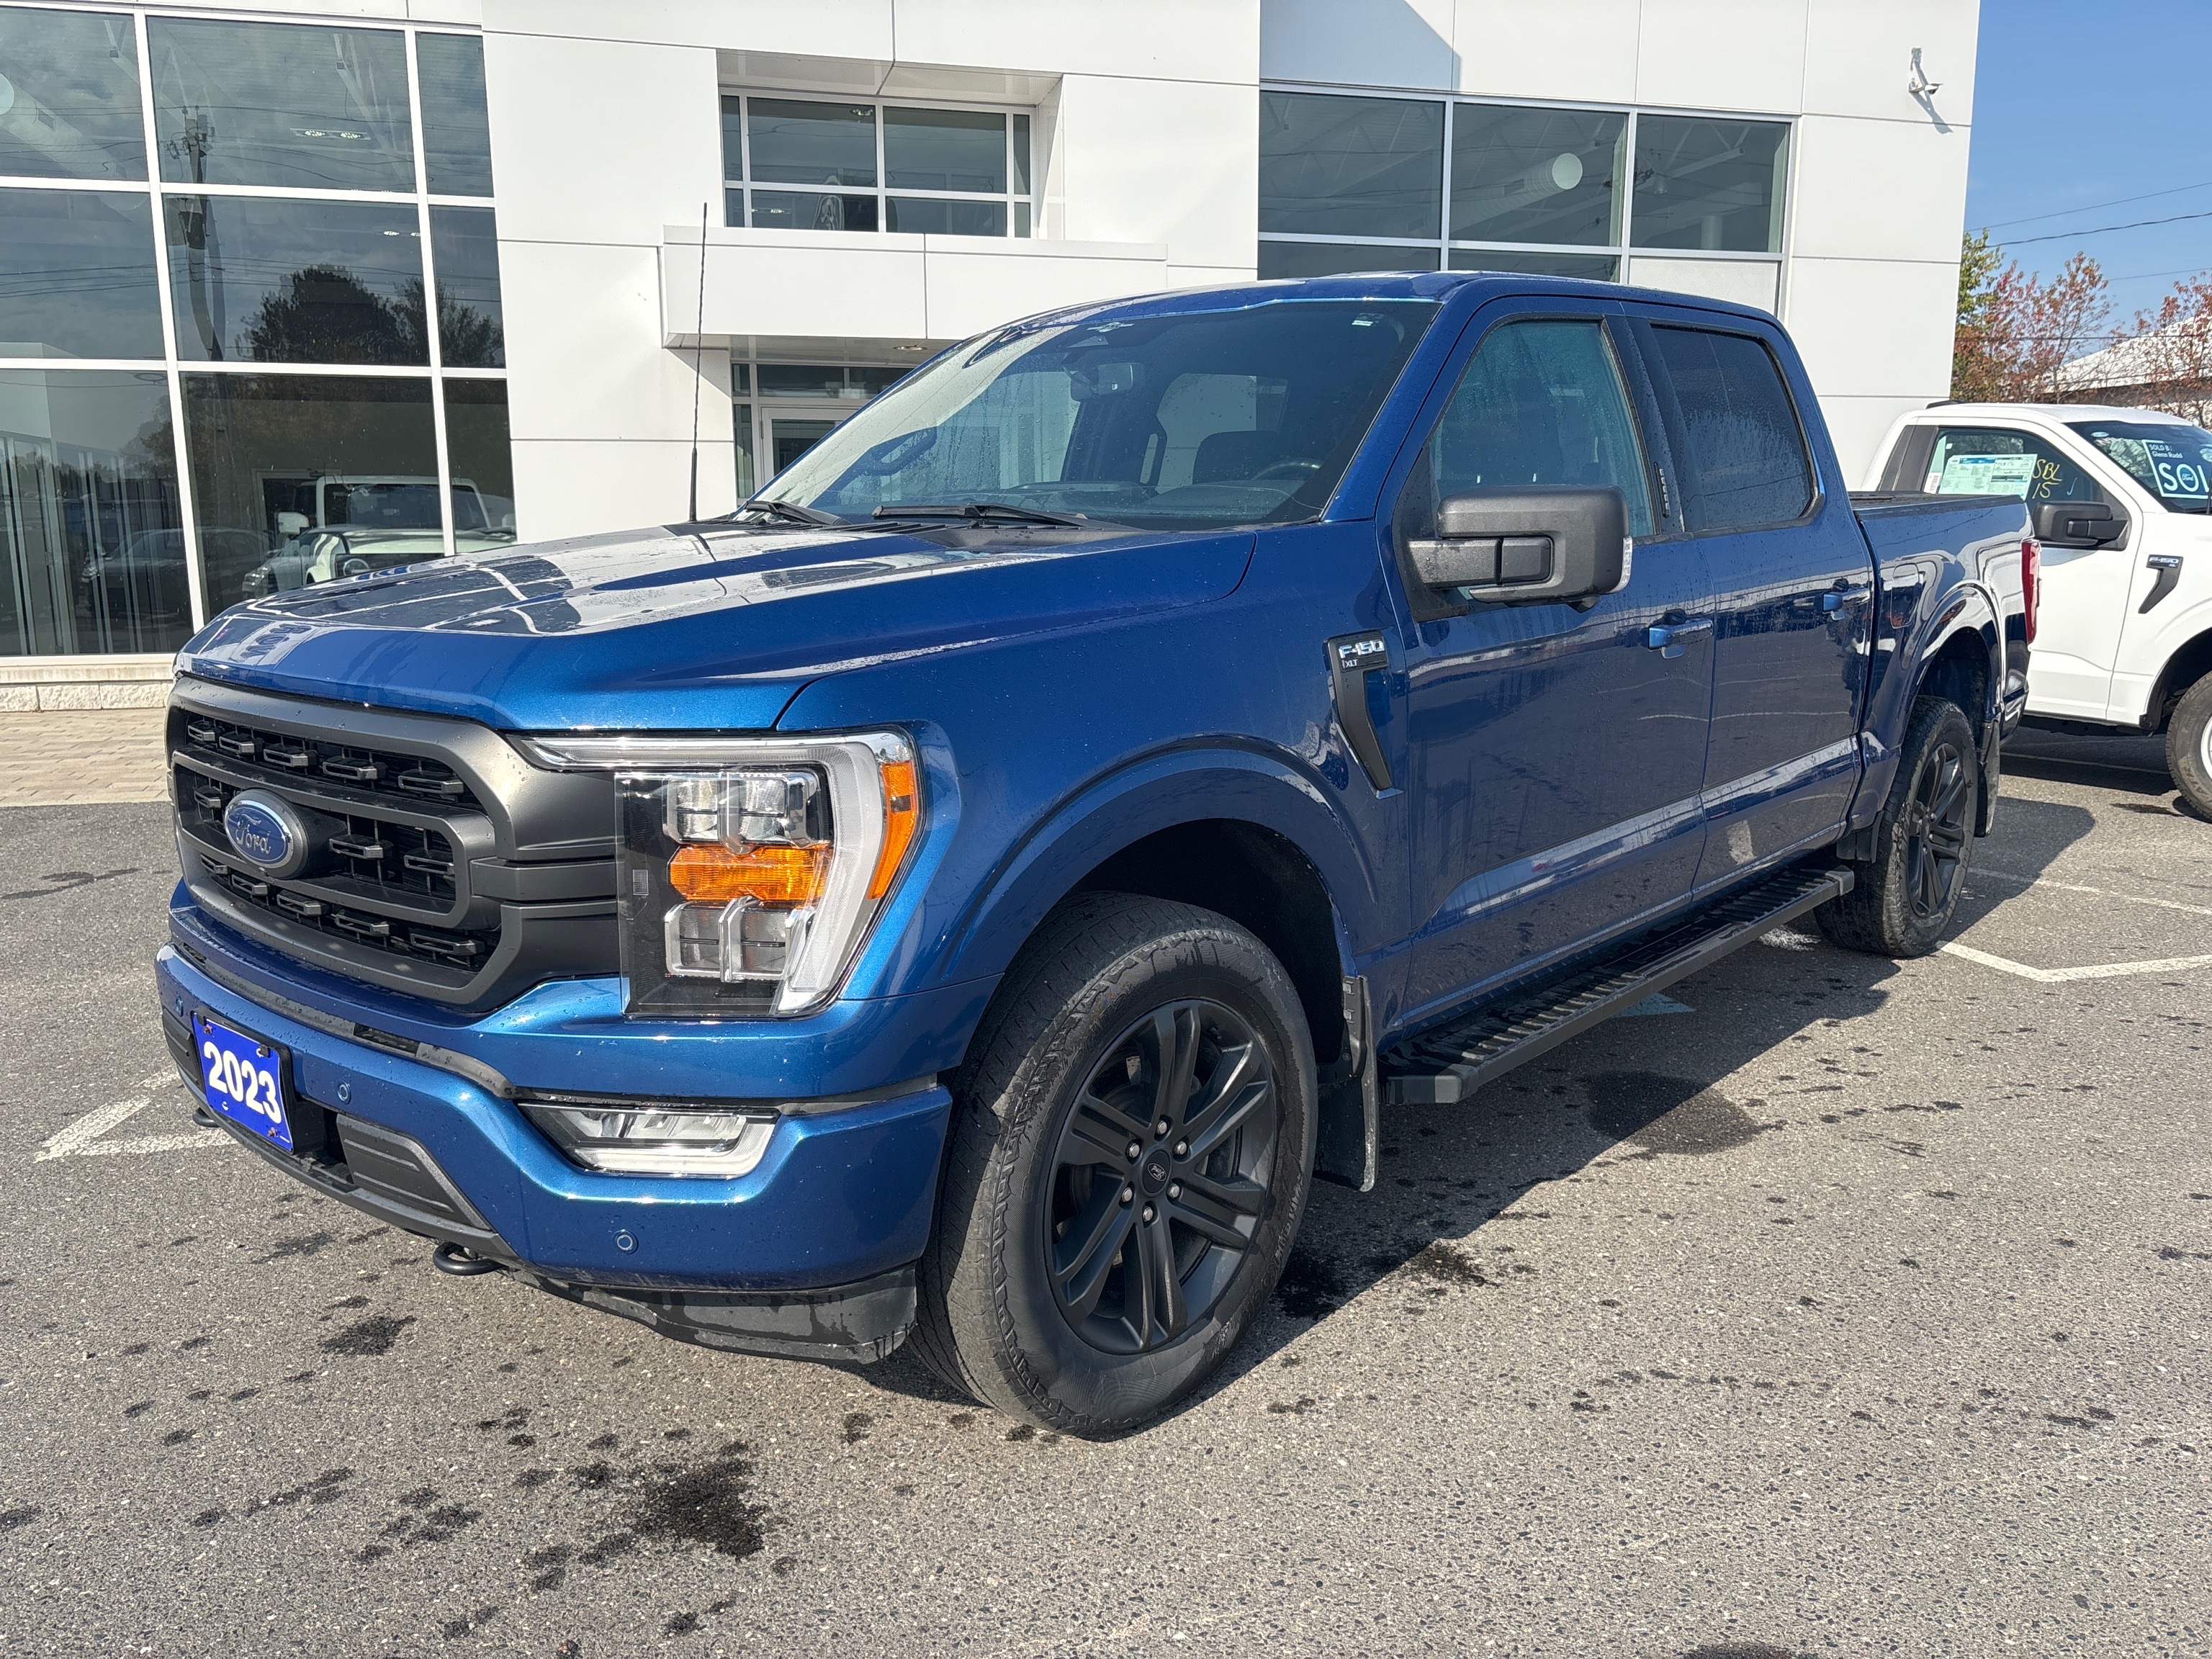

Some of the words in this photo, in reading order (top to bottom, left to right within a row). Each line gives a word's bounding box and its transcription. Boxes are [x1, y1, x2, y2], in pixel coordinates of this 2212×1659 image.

[1339, 639, 1385, 659] F-150
[1344, 659, 1358, 667] XLT
[235, 813, 271, 855] Ford
[203, 1040, 282, 1124] 2023
[1151, 1164, 1165, 1179] Ford
